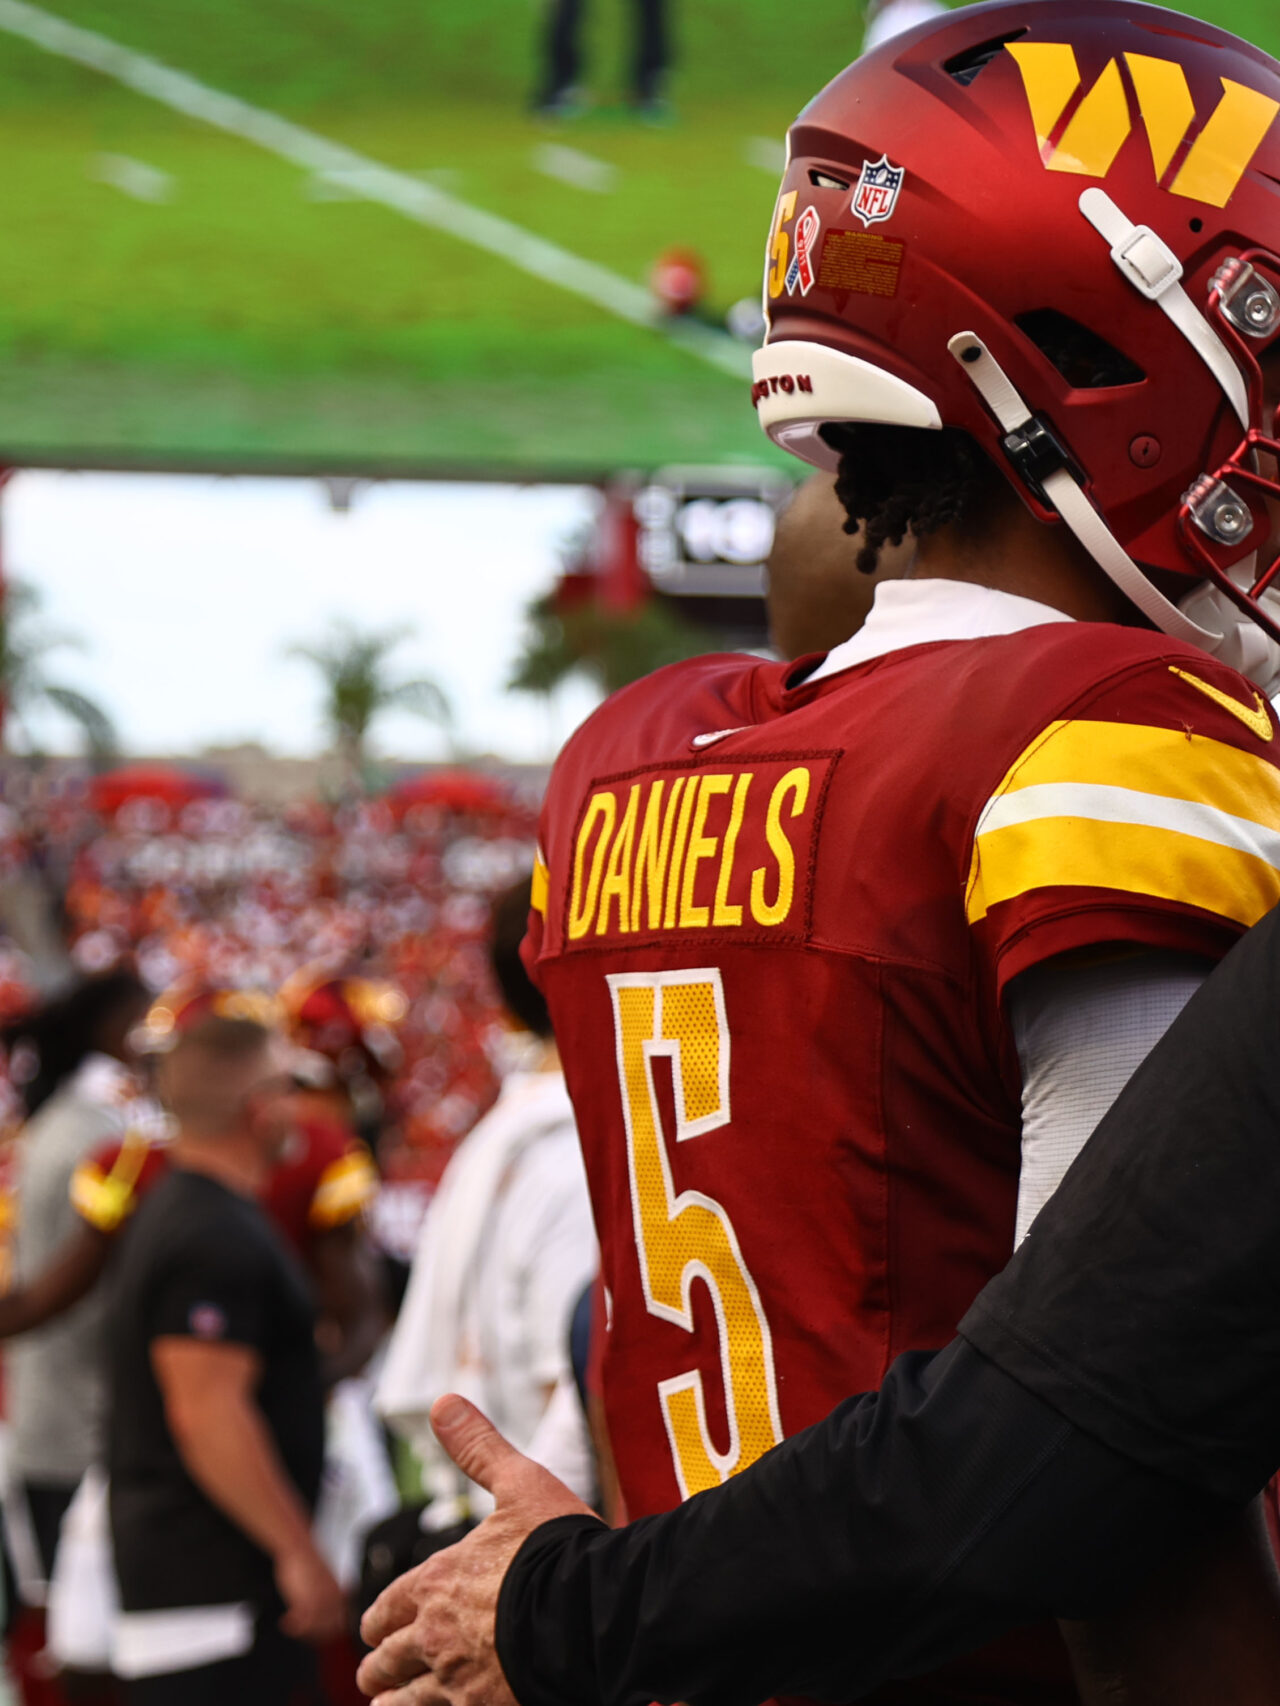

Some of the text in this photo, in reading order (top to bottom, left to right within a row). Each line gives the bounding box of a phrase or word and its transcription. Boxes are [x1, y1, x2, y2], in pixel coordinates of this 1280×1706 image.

[858, 185, 889, 215] NFL
[1003, 42, 1280, 209] W
[768, 190, 798, 299] 5
[568, 767, 809, 940] DANIELS
[605, 968, 784, 1501] 5
